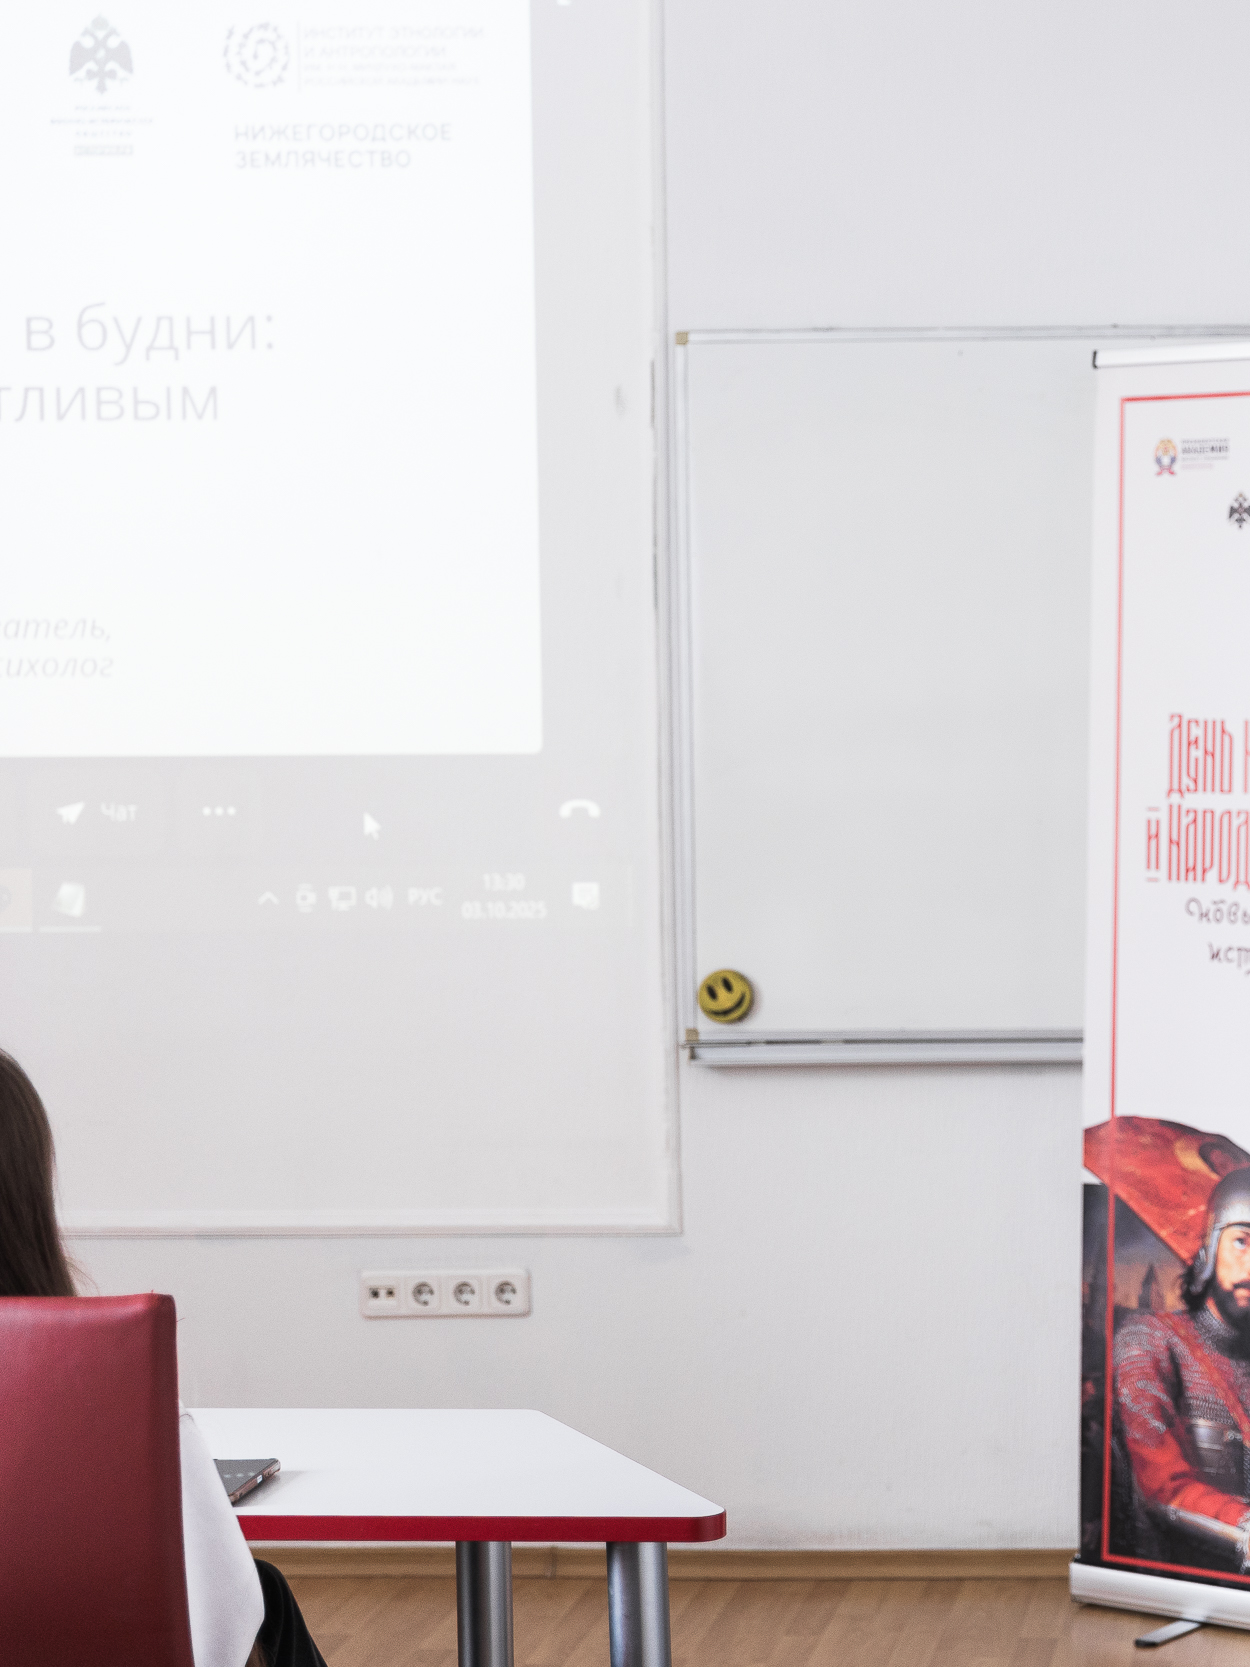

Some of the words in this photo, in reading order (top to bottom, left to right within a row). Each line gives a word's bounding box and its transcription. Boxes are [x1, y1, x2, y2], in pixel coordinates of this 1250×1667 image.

[234, 122, 453, 144] НИЖЕГОРОДСКОЕ
[235, 149, 412, 170] ЗЕМЛЯЧЕСТВО
[25, 315, 57, 353] в
[76, 301, 274, 367] будни:
[0, 617, 111, 644] атель,
[0, 656, 116, 679] ихолог
[99, 801, 138, 823] Чат
[482, 872, 526, 892] 13:30
[408, 886, 444, 906] РУС
[460, 900, 548, 920] 03.10.2025
